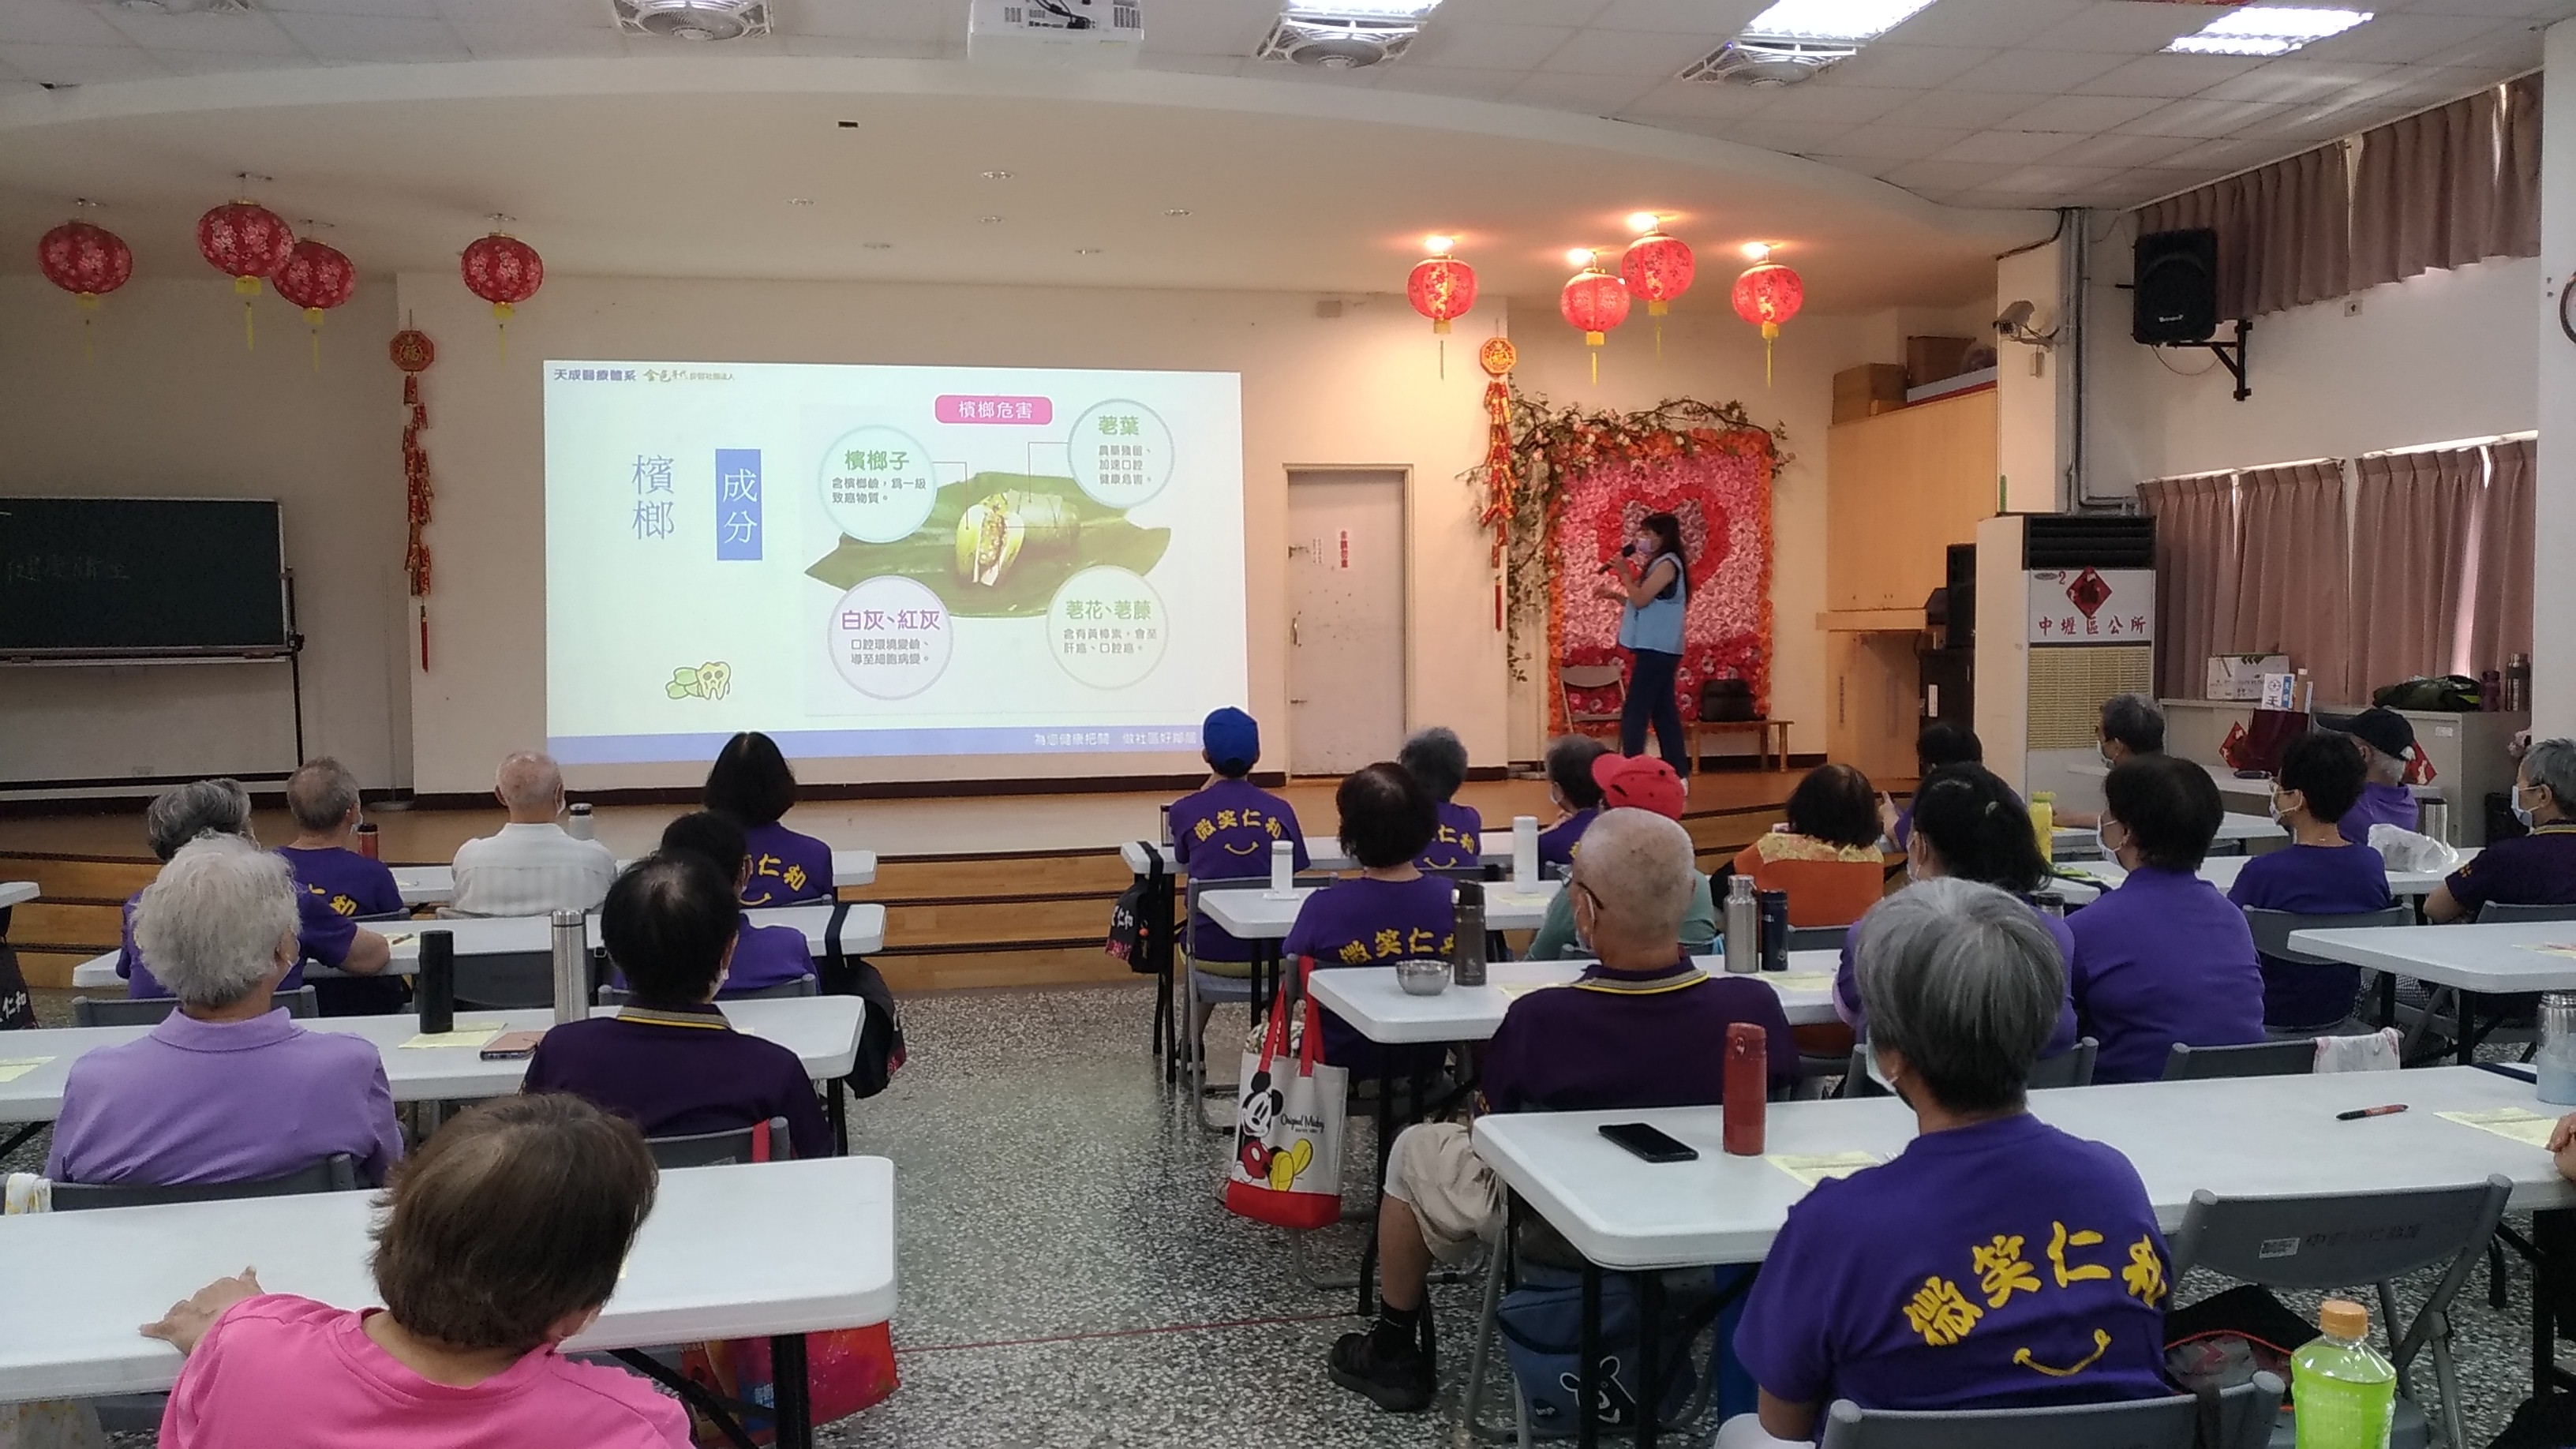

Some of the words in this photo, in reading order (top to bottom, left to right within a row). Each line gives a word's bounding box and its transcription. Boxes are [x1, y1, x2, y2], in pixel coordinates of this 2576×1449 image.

[554, 368, 638, 382] 天成醫療體系
[958, 400, 1033, 420] 檳榔危害
[844, 449, 910, 472] 檳榔子
[631, 454, 676, 541] 檳榔
[721, 467, 759, 545] 成分
[2057, 570, 2067, 586] 2
[841, 609, 942, 631] 白灰、紅灰
[2038, 615, 2147, 637] 中壢區公所
[1193, 807, 1283, 843] 微笑仁和
[1431, 822, 1477, 856] 仁和
[0, 990, 27, 1024] 仁和
[1902, 1219, 2169, 1347] 微笑仁和
